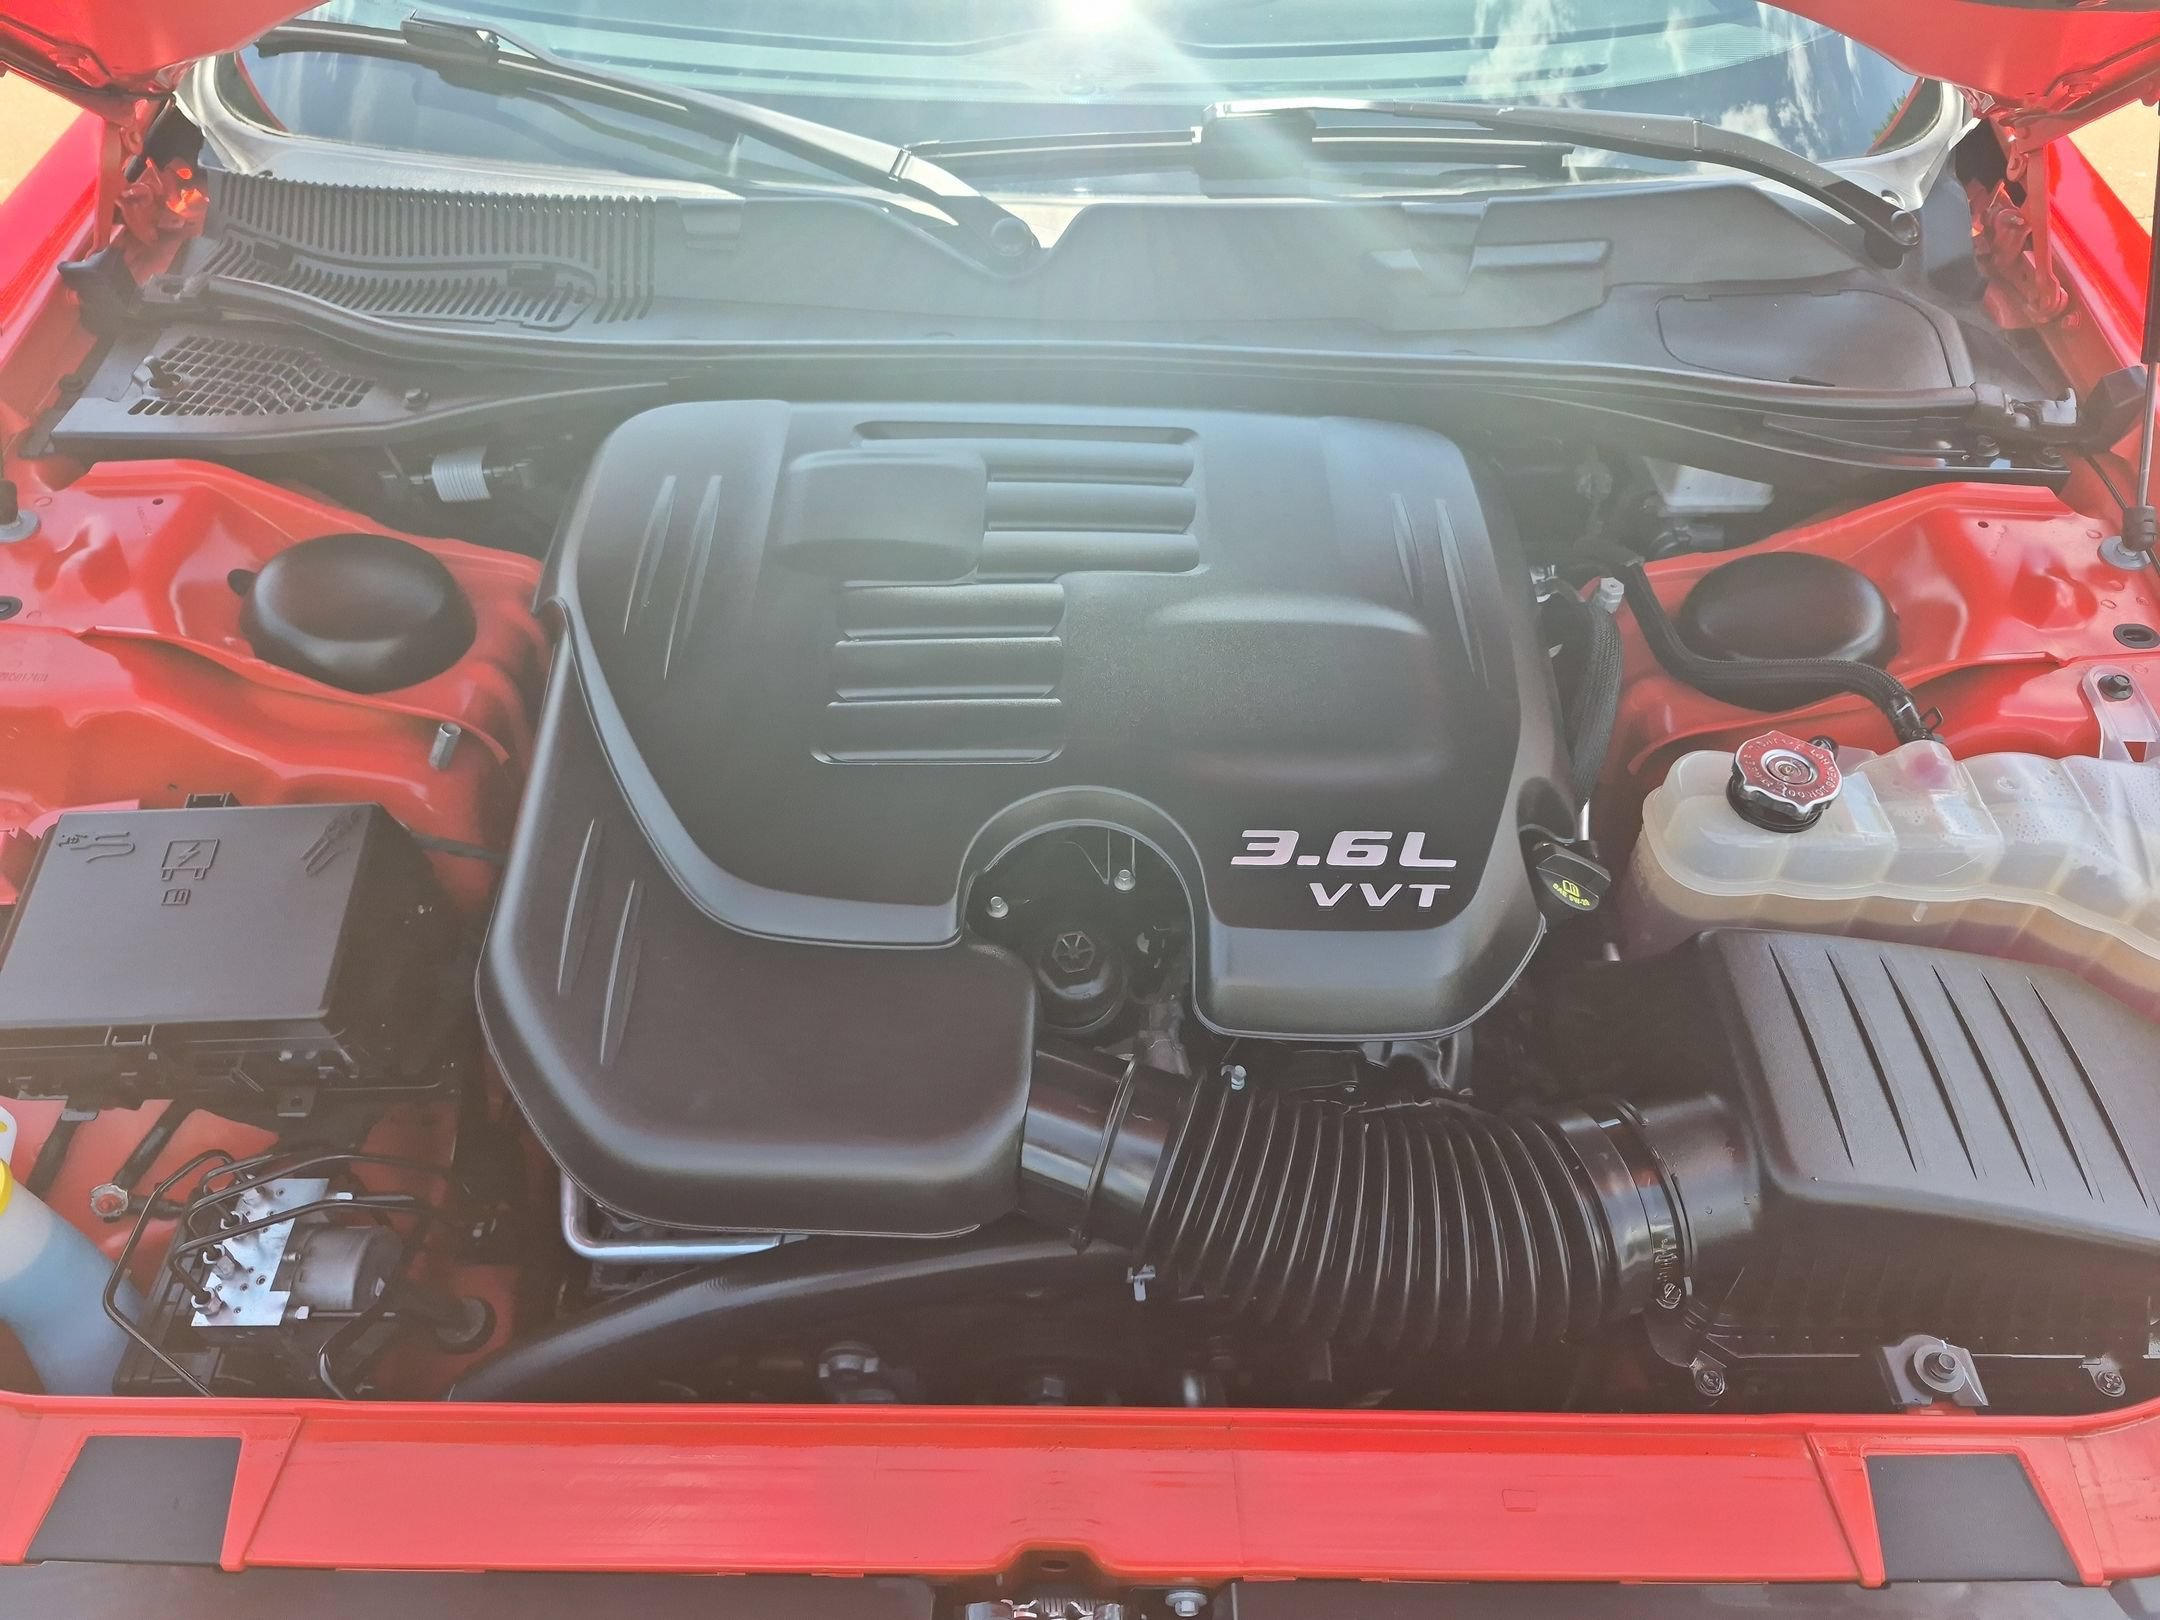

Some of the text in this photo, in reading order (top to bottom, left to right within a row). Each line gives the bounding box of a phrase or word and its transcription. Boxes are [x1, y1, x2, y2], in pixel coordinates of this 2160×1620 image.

[1807, 785, 1829, 798] NOT
[1825, 765, 1837, 789] OPEN
[1230, 829, 1457, 868] 3.6L
[1309, 883, 1451, 908] VVT
